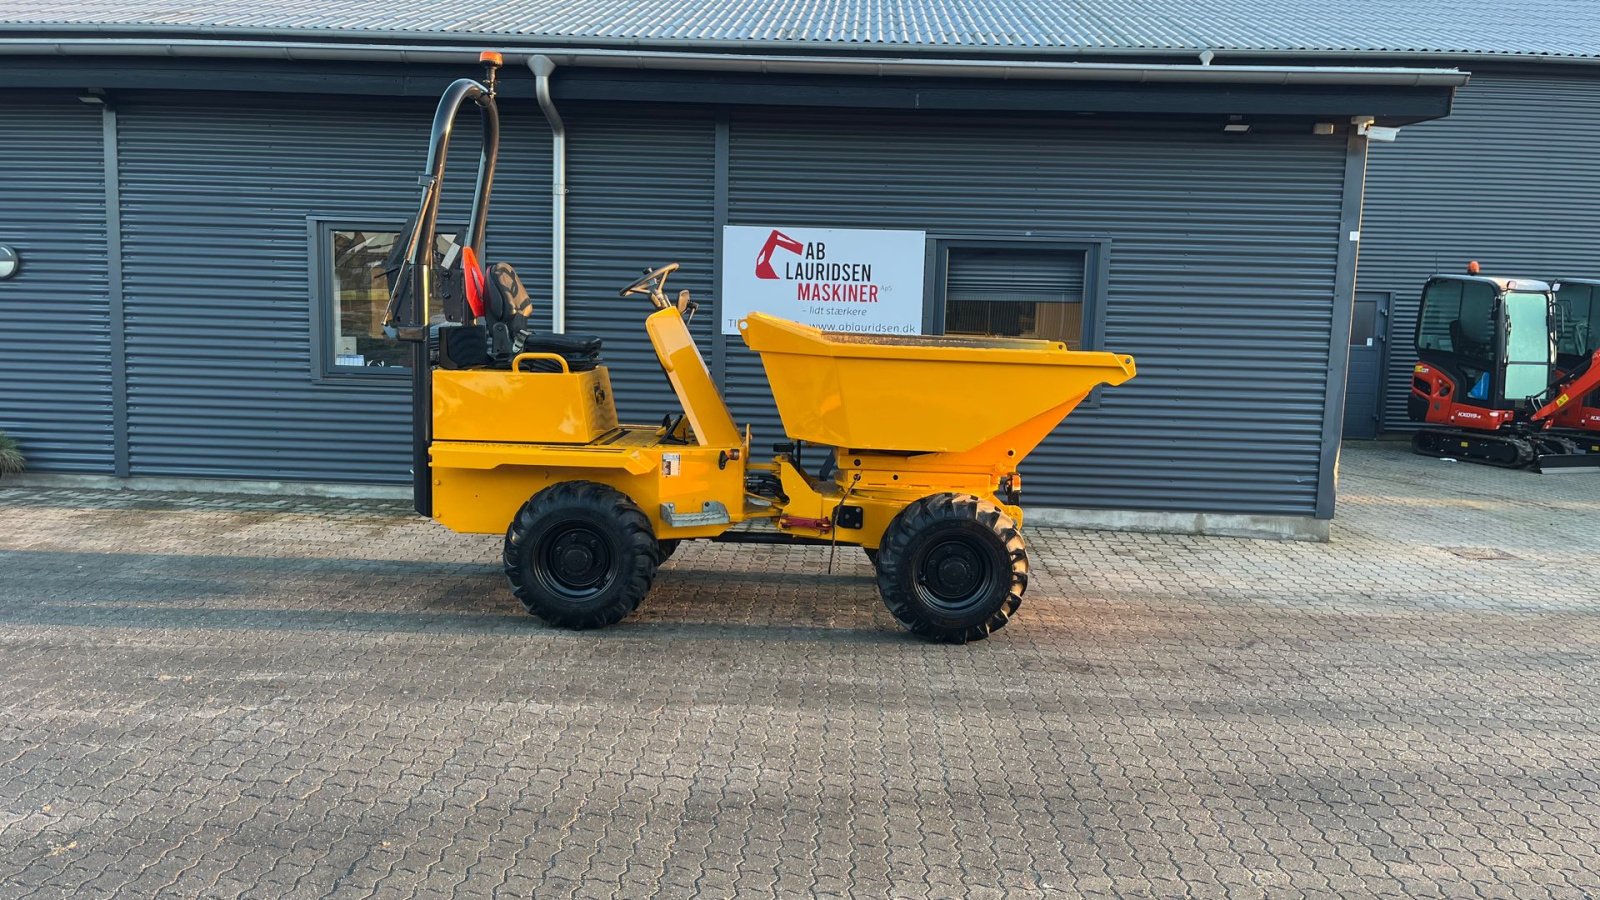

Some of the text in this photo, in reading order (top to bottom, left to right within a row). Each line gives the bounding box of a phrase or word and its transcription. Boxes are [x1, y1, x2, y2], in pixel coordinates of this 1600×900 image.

[805, 242, 825, 260] AB
[786, 262, 871, 282] LAURIDSEN
[798, 283, 878, 303] MASKINER
[809, 306, 824, 316] lidt
[826, 307, 867, 316] stærkere
